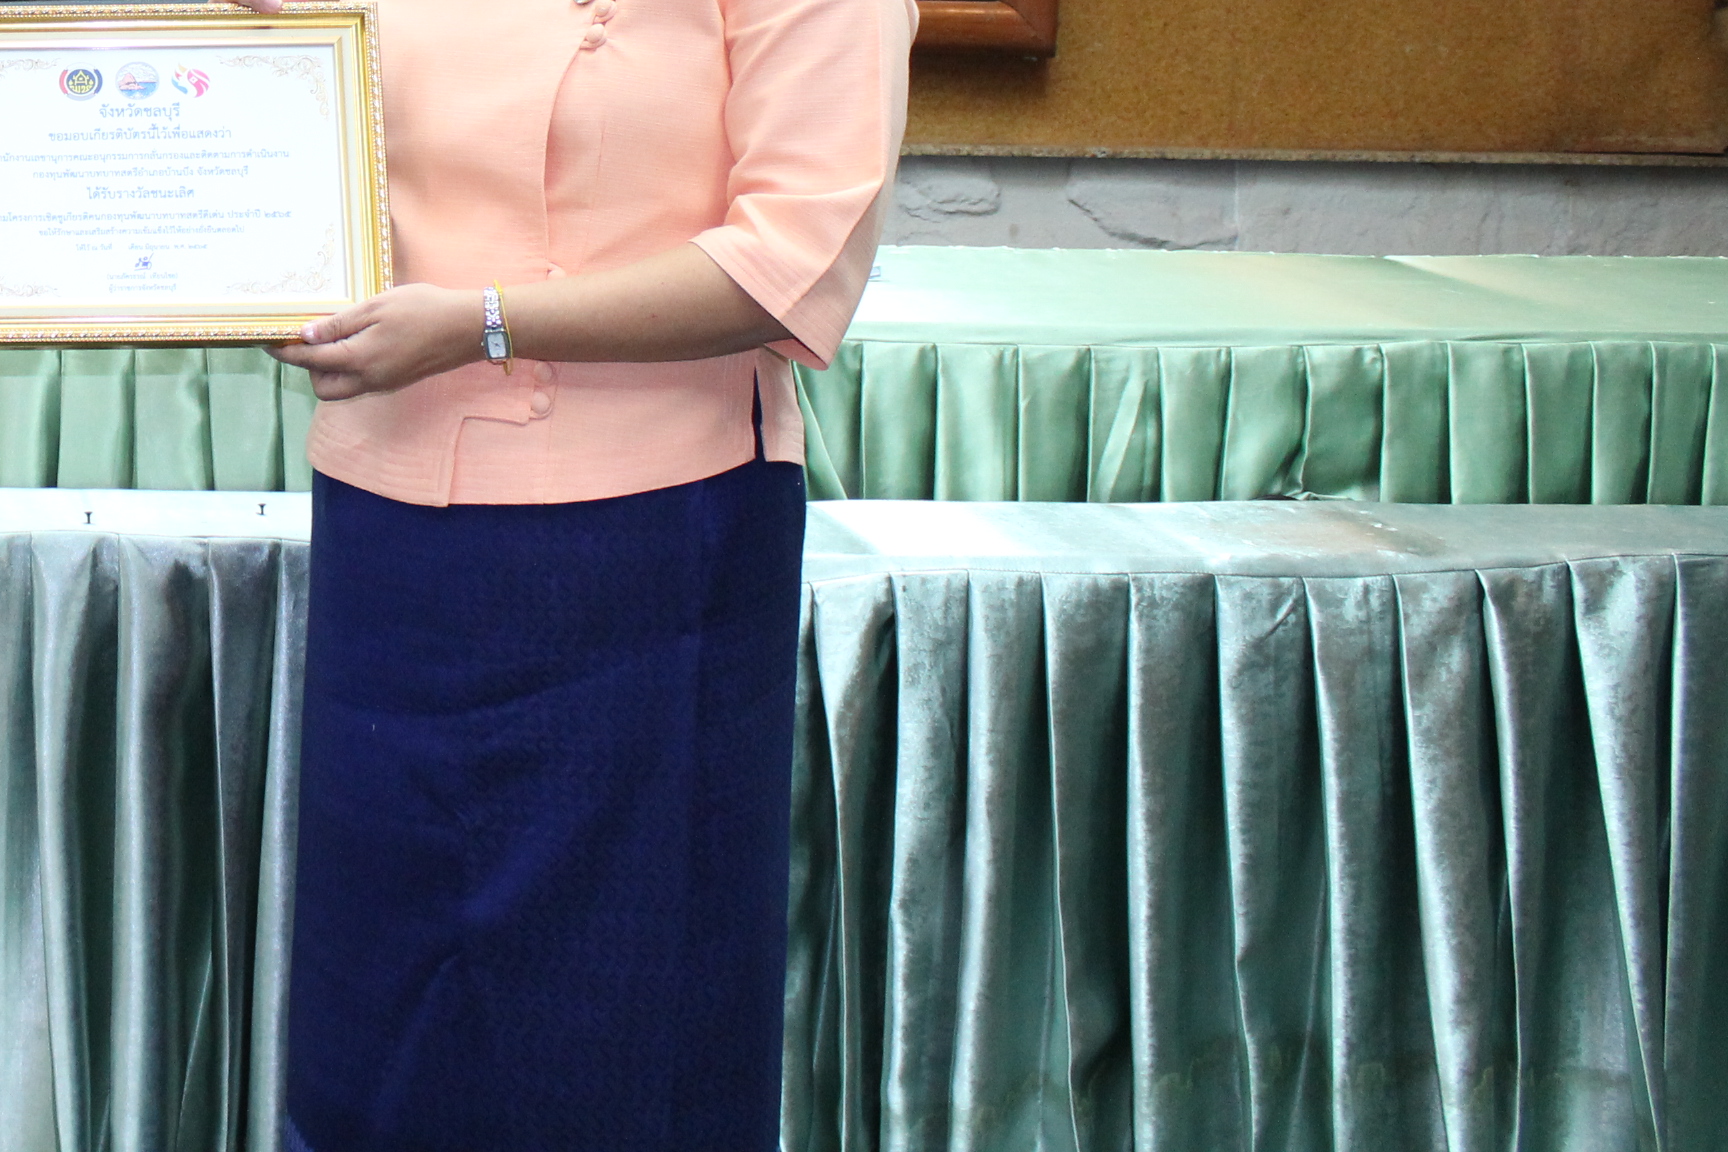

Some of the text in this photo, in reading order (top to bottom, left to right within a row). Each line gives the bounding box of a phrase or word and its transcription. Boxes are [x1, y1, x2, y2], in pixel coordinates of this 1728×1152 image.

[99, 102, 180, 121] จังหวัดชลบุรี
[48, 124, 231, 141] ขอมอบเกียรติบัตรนี้ไว้เพื่อแสดงว่า
[197, 165, 248, 177] จังหวัดชลบุรี
[86, 186, 195, 200] ได้รับรางวัลชนะเลิศ
[226, 208, 262, 219] ประจำปี
